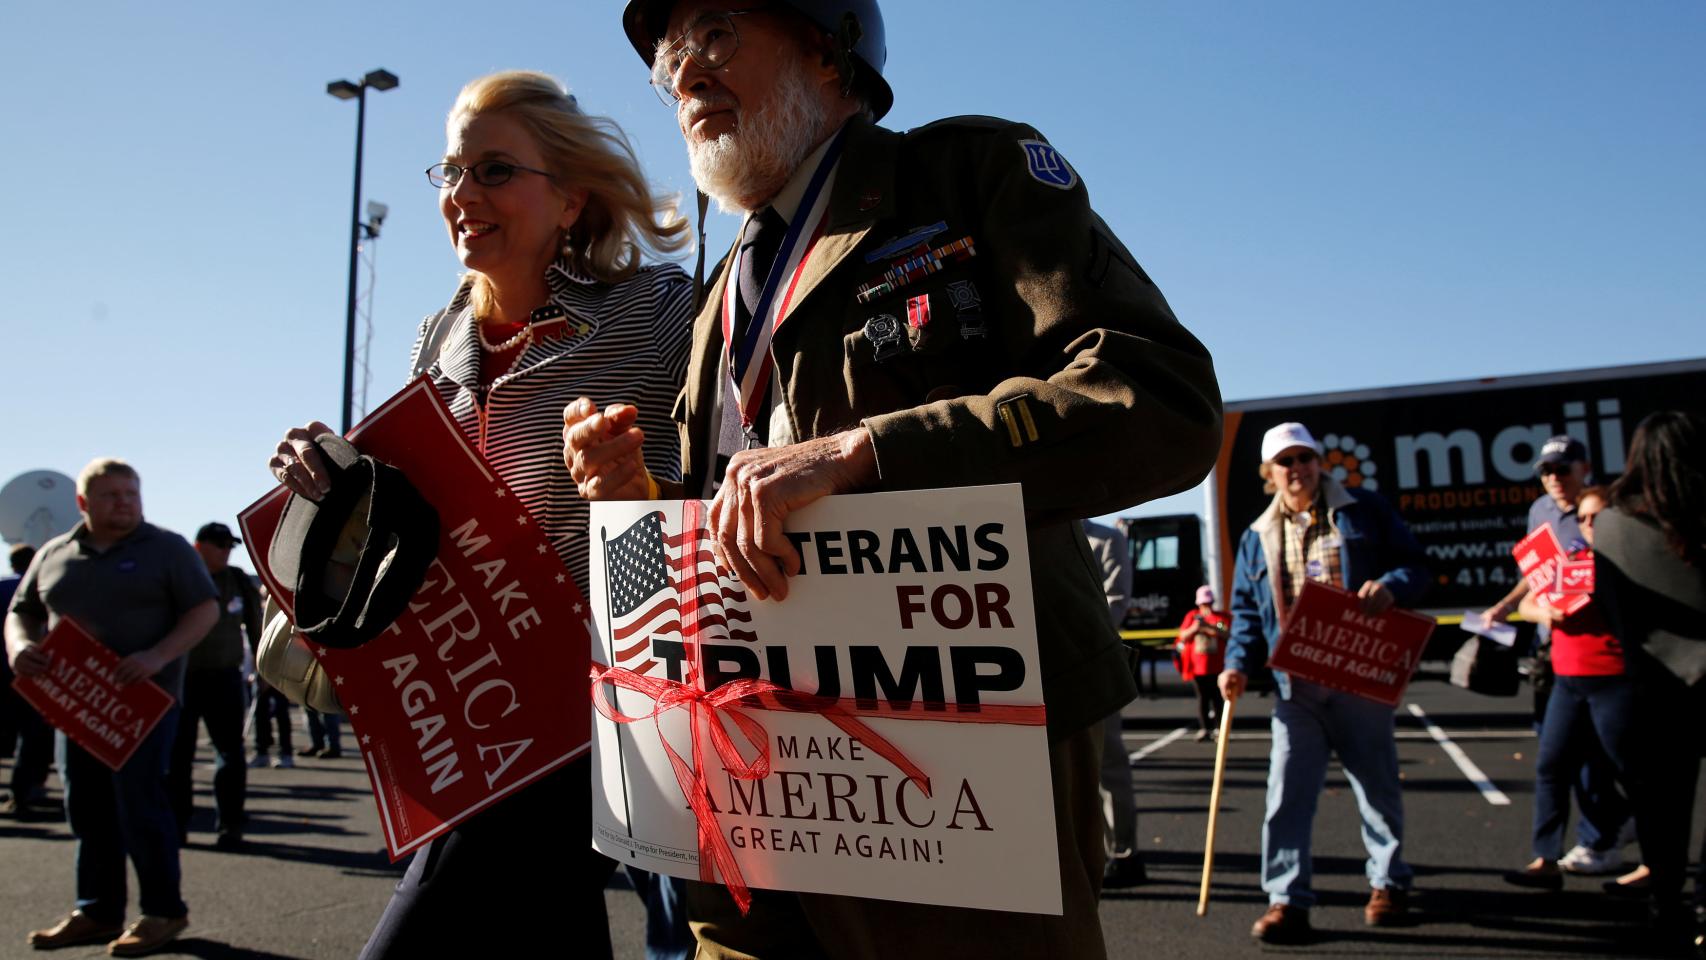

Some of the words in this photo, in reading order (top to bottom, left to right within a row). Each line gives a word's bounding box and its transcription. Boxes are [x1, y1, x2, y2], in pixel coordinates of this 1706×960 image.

[1395, 399, 1626, 488] maji
[1399, 486, 1539, 510] PRODUCTION
[782, 522, 1010, 576] TERANS
[449, 517, 542, 640] MAKE
[896, 581, 1016, 630] FOR
[1341, 609, 1388, 633] MAKE
[1289, 616, 1413, 671] AMERICA
[1290, 642, 1344, 670] GREAT
[1343, 659, 1399, 686] AGAIN
[408, 556, 534, 790] ERICA
[652, 638, 1027, 714] TRUMP
[73, 708, 127, 750] AGAIN
[381, 651, 464, 794] AGAIN
[777, 734, 865, 762] MAKE
[634, 841, 650, 853] Trump
[650, 845, 658, 854] for
[658, 848, 688, 862] President,
[730, 825, 821, 855] GREAT
[834, 832, 944, 865] AGAIN!
